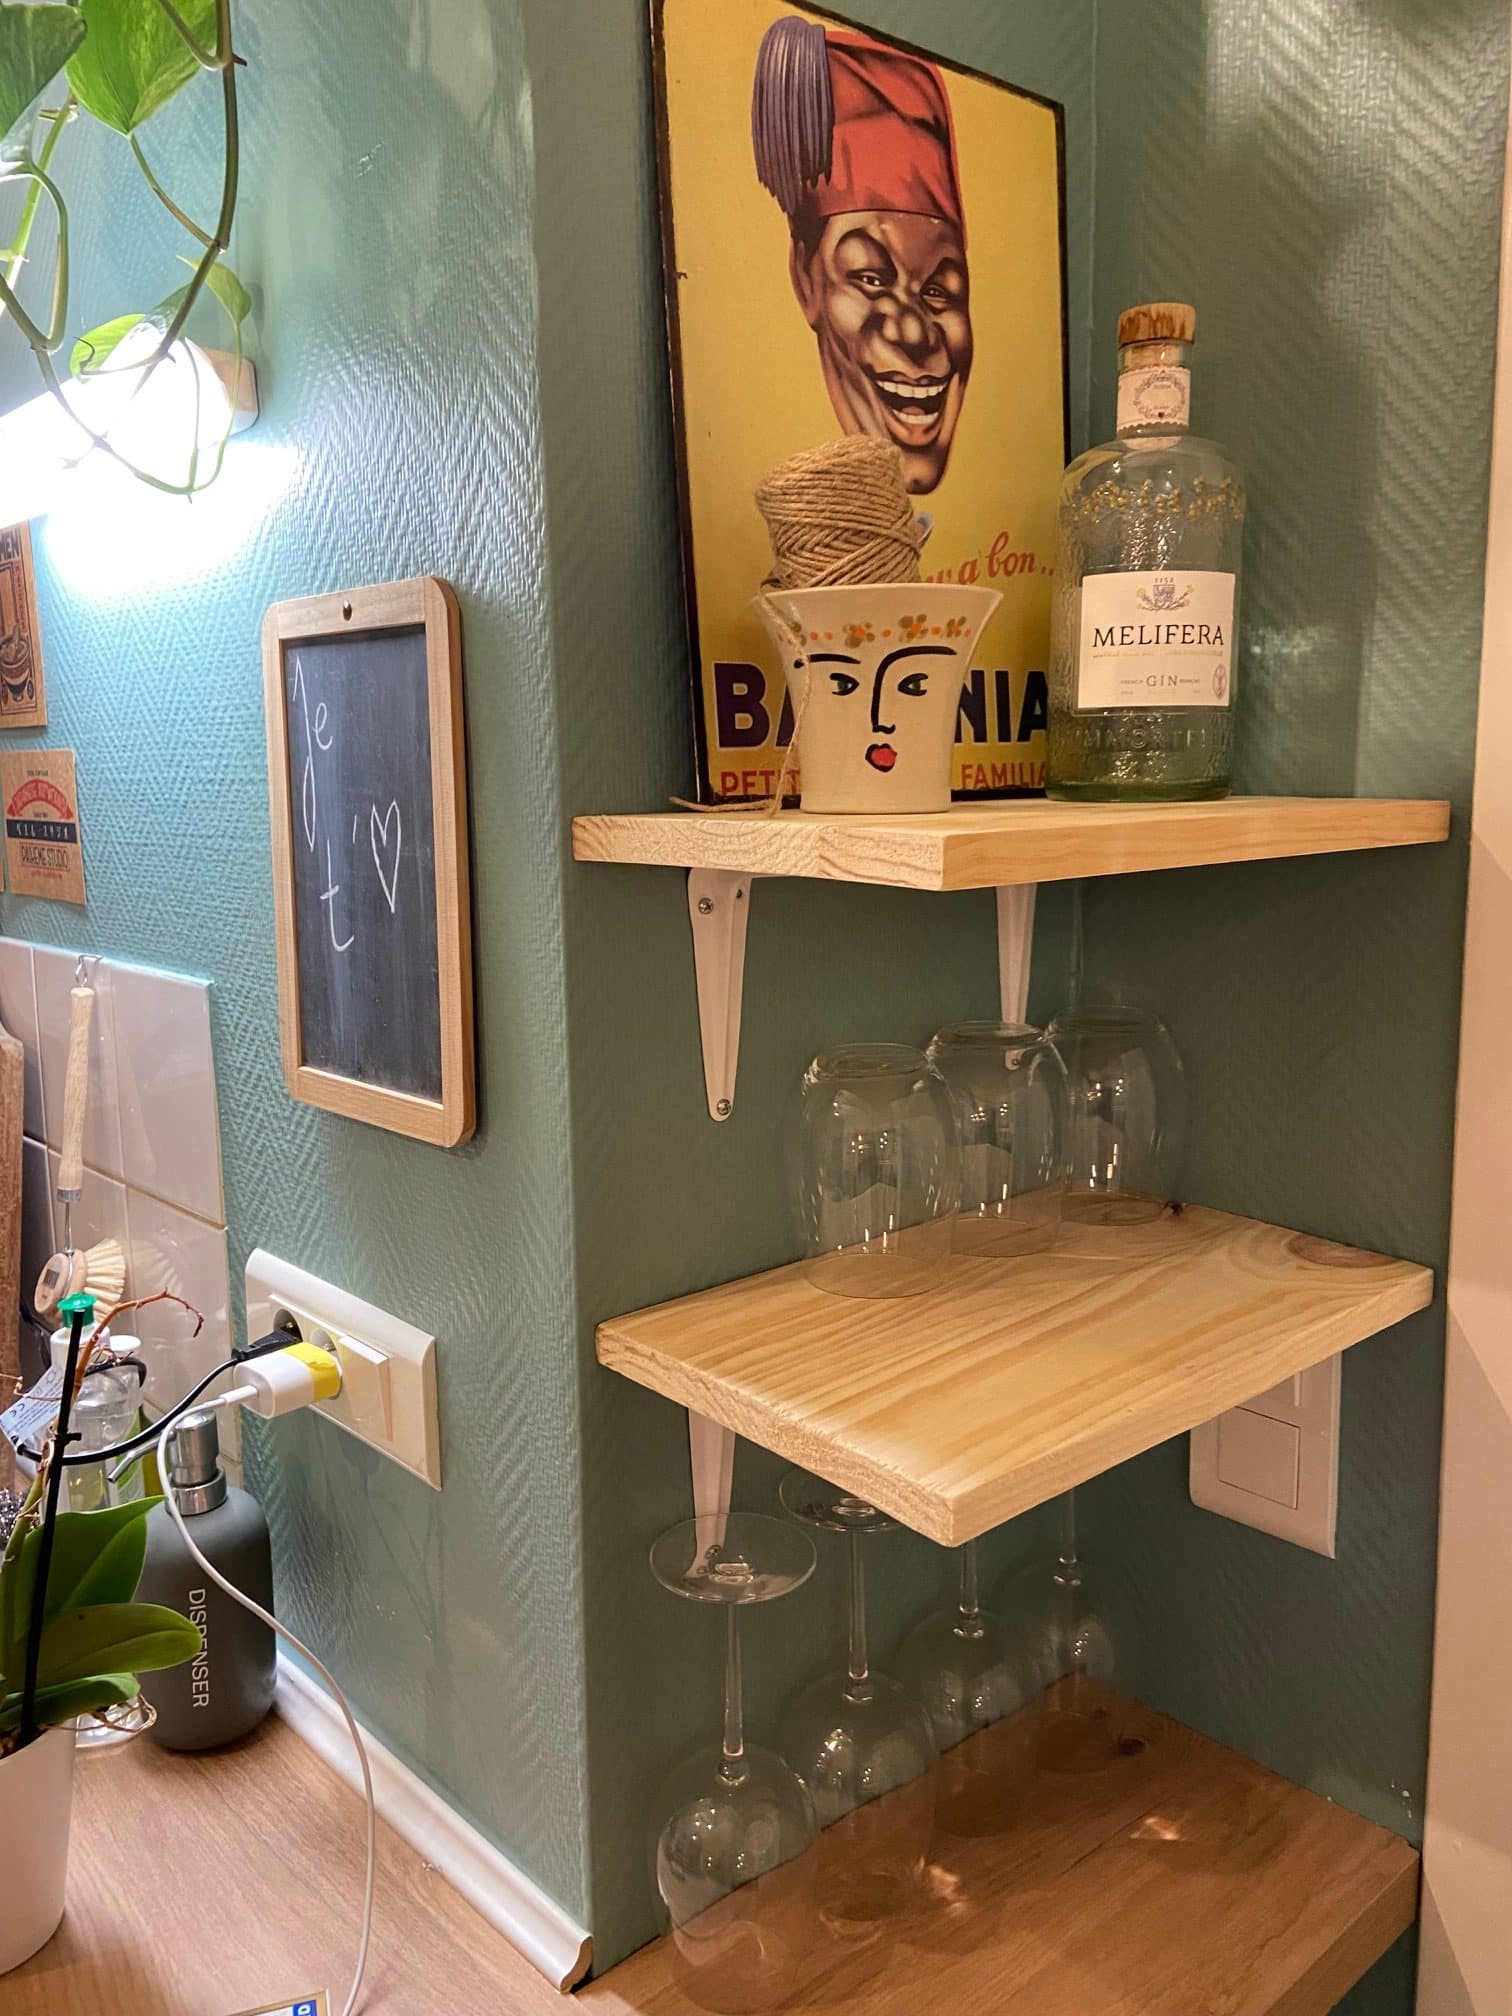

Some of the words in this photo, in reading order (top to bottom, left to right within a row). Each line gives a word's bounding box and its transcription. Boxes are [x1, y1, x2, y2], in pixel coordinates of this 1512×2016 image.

[1092, 624, 1224, 648] MELIFERA
[1146, 675, 1178, 687] GIN
[292, 655, 333, 853] Je
